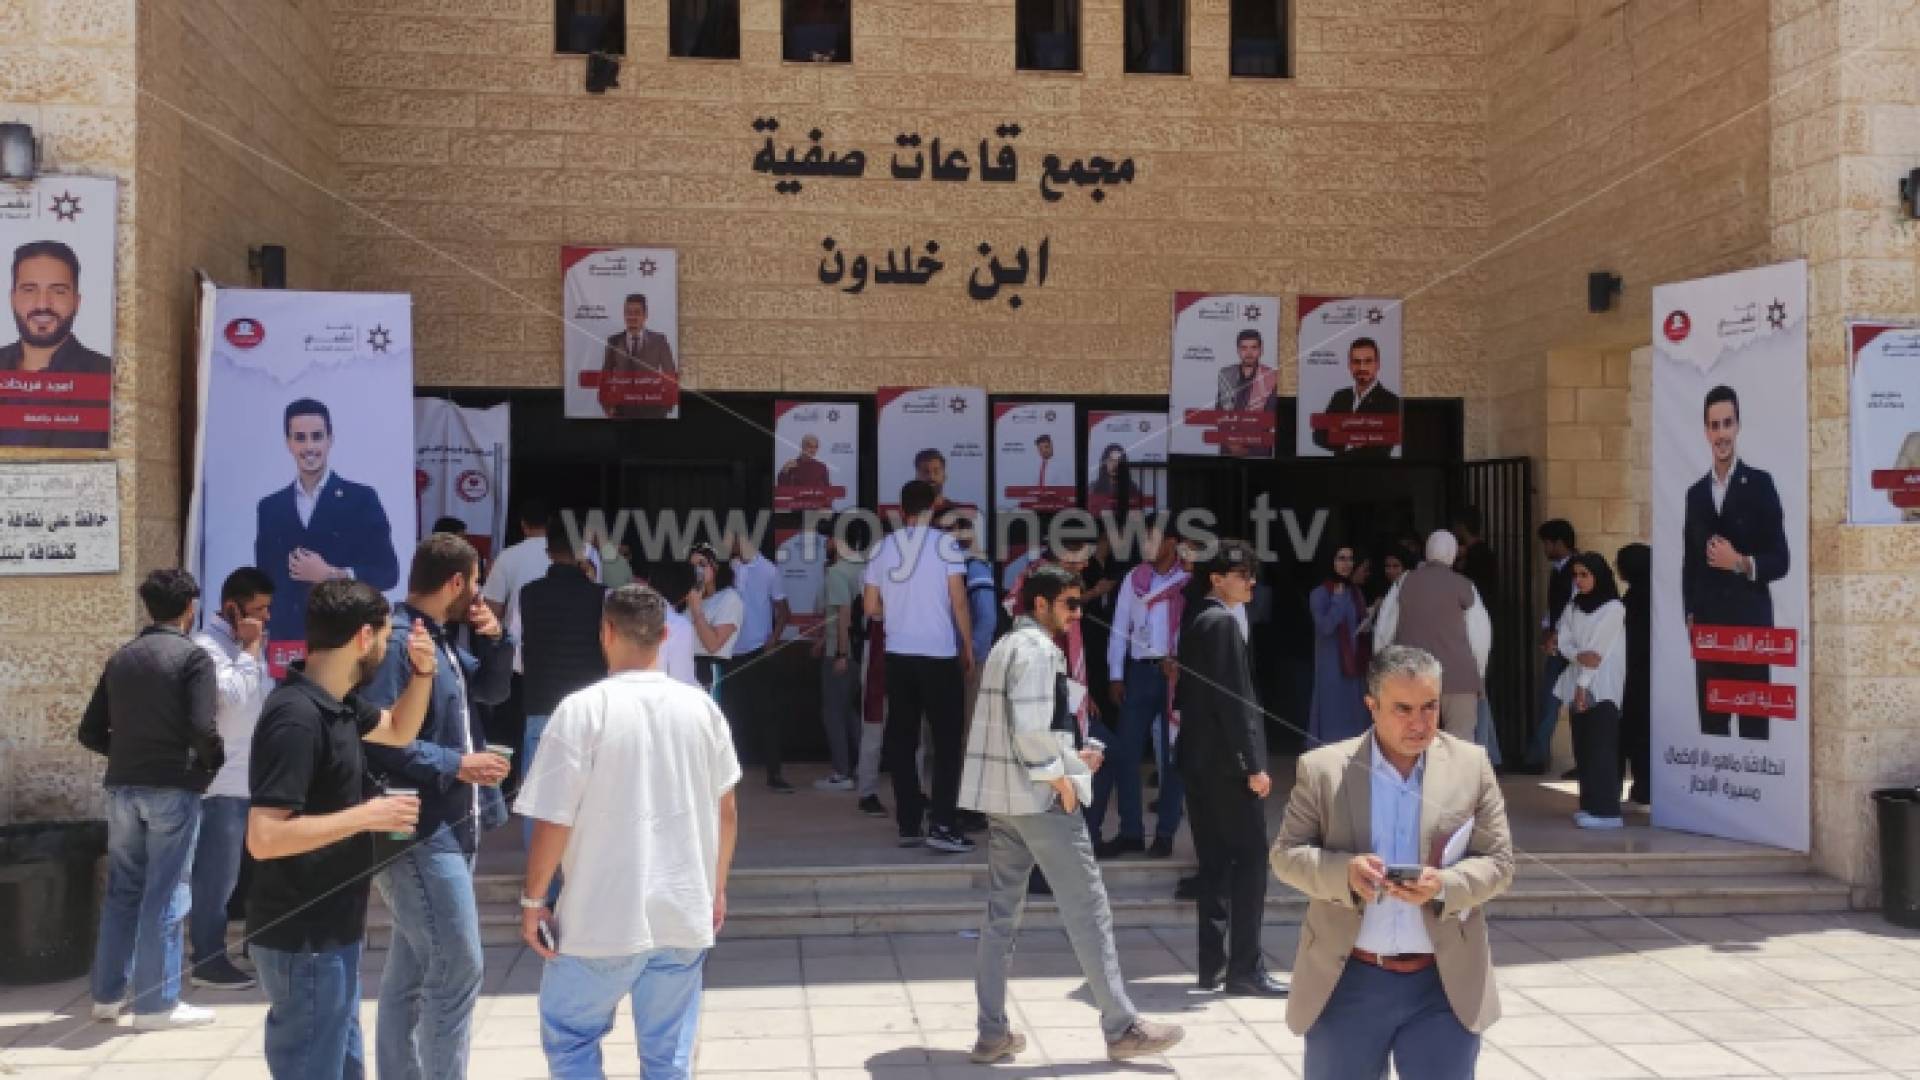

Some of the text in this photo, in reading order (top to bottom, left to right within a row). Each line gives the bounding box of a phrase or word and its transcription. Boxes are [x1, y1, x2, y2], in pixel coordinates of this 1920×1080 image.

[752, 116, 1135, 202] مجمع قاعات صفية
[817, 235, 1049, 309] ابن خلدون
